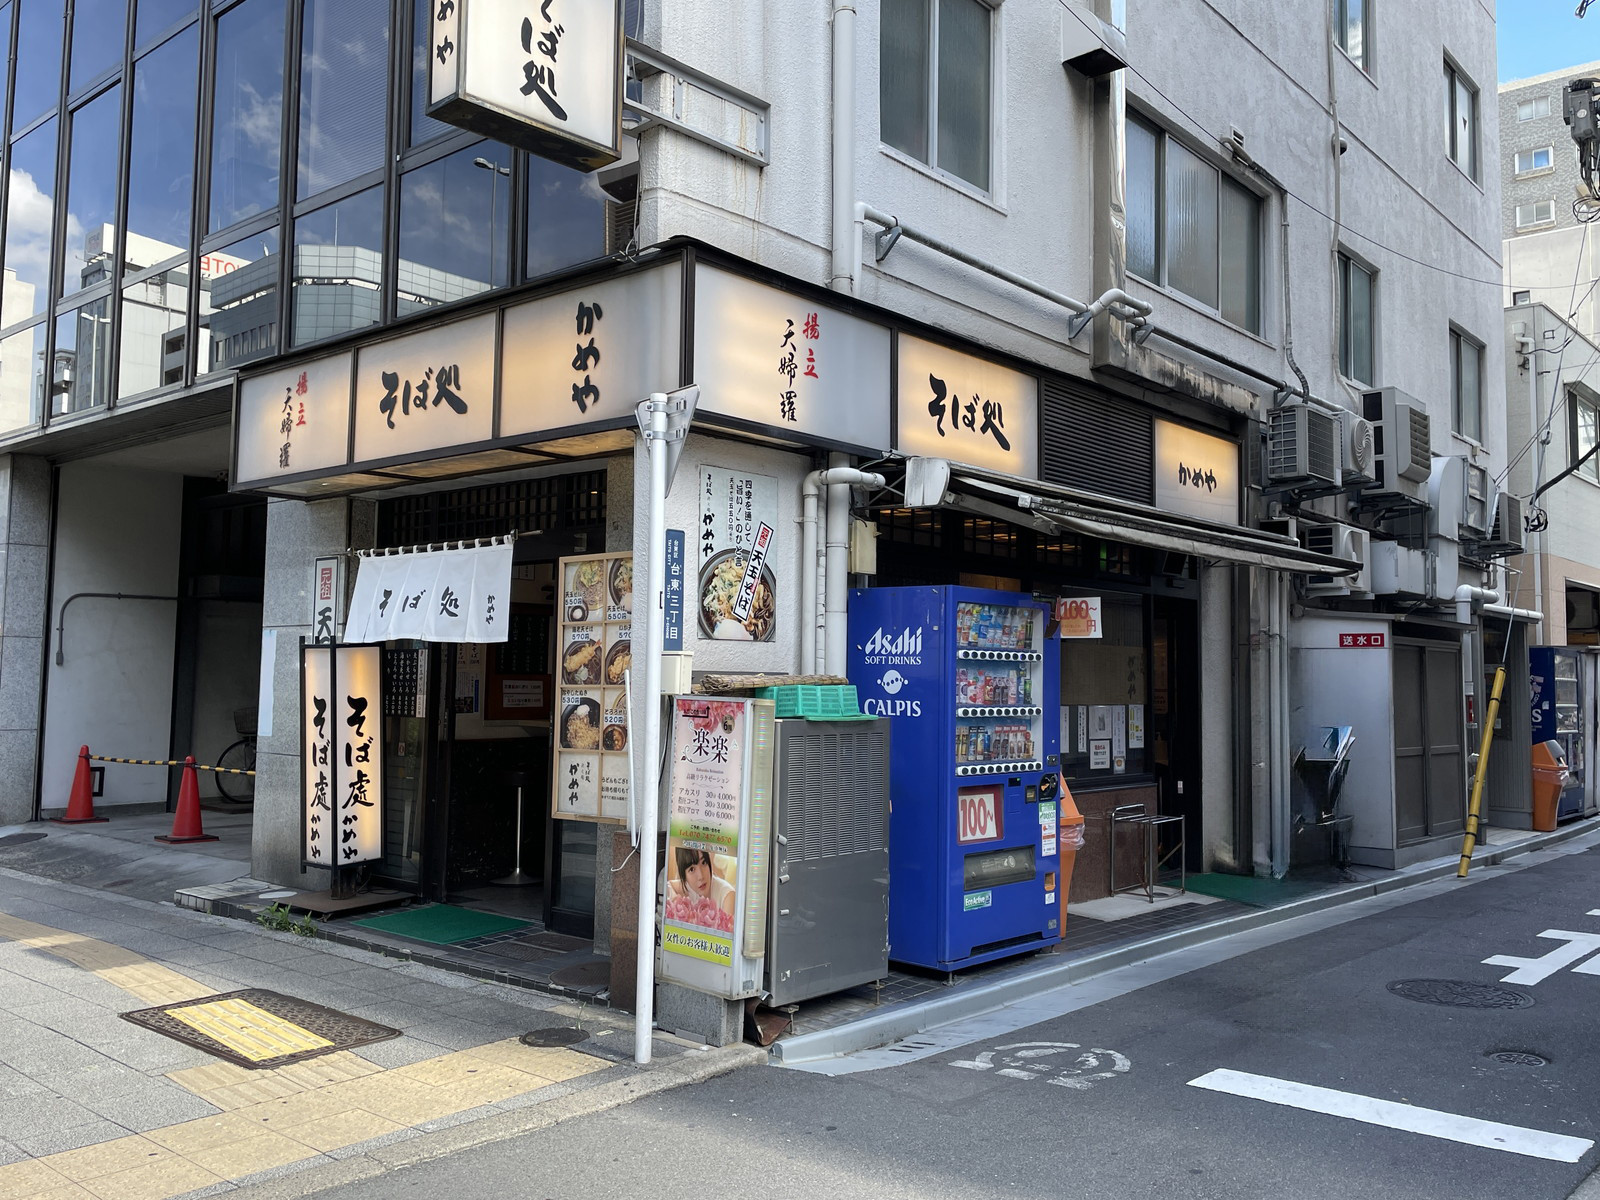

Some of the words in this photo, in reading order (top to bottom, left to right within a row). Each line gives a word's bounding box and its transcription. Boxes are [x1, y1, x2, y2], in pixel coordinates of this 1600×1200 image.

[572, 301, 602, 413] かめや
[803, 312, 820, 380] 揚立
[777, 318, 798, 423] 天婦羅
[295, 370, 308, 427] 揚立
[380, 364, 468, 429] そば処
[929, 372, 1012, 452] そば処
[279, 387, 294, 468] 天婦羅
[1179, 461, 1218, 493] かめや
[702, 512, 715, 557] かめや
[320, 567, 333, 600] 元祖
[379, 586, 460, 618] そば処
[669, 562, 680, 640] 台東三丁目
[738, 549, 764, 613] 天玉そば
[317, 606, 333, 644] 天
[485, 594, 496, 625] かめや
[864, 626, 923, 655] Asahi
[864, 655, 887, 665] SOFT
[888, 656, 922, 665] DRINKS
[1343, 635, 1381, 646] 送水口
[562, 696, 580, 704] 530円
[604, 716, 624, 724] 520円
[863, 698, 922, 717] CALPIS
[693, 728, 728, 763] 楽楽
[568, 763, 580, 806] かめや
[310, 814, 321, 859] かめや
[342, 814, 358, 860] かめや
